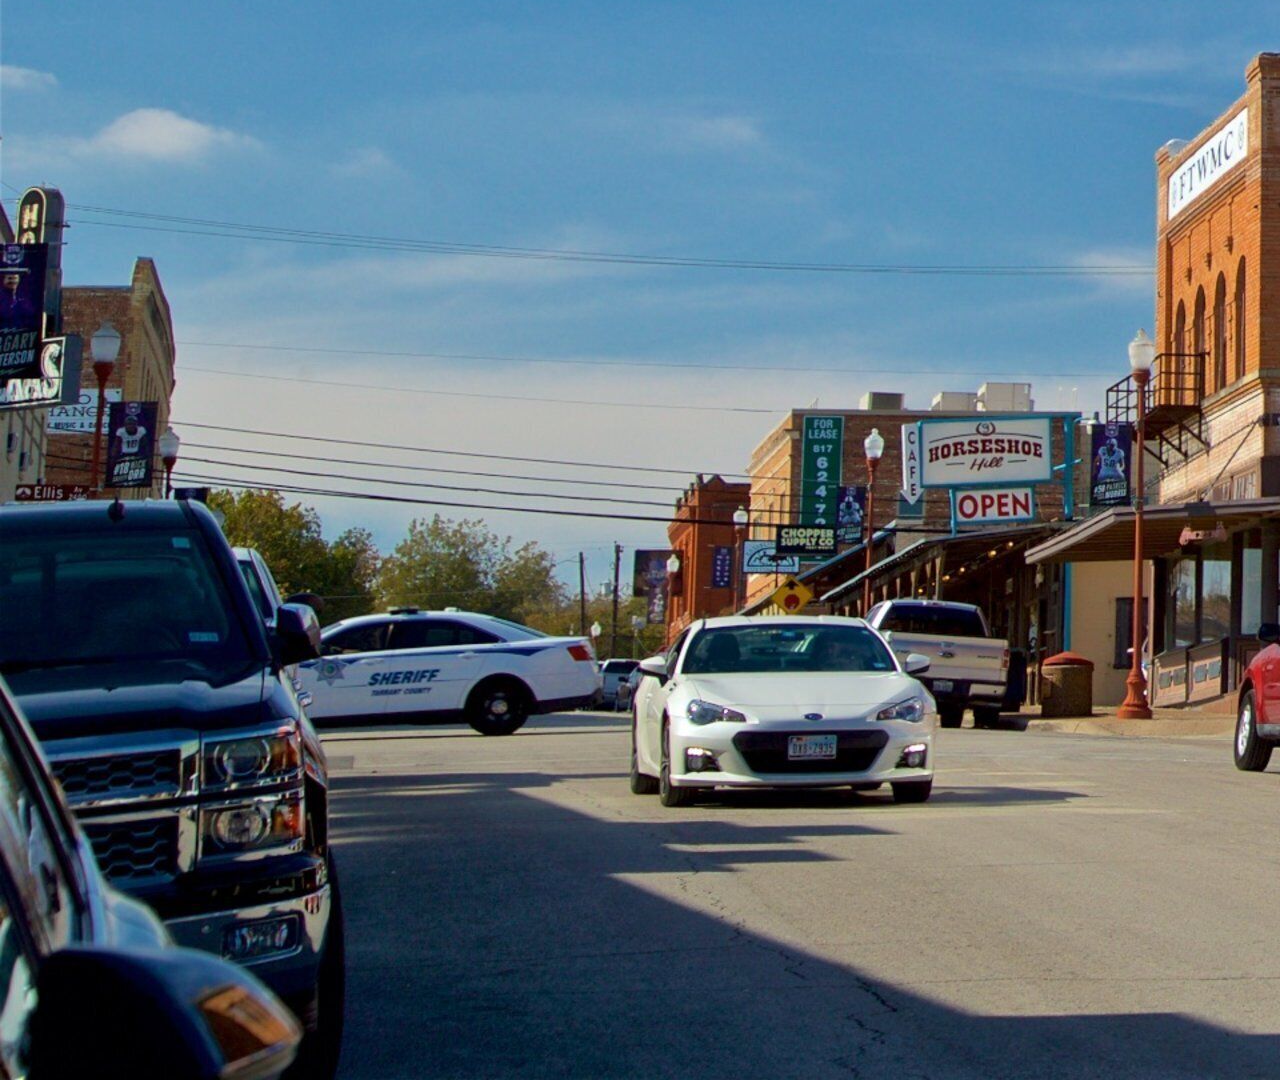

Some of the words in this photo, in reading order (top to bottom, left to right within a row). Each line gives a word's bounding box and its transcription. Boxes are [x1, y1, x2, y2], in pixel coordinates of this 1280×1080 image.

[1180, 130, 1234, 201] FTWMC
[814, 419, 833, 429] FOR
[809, 429, 838, 439] LEASE
[813, 444, 833, 453] 817
[928, 438, 1043, 464] HORSESHOE
[907, 431, 918, 497] CAFE
[969, 456, 1005, 472] Hill
[34, 486, 64, 500] Ellis
[958, 492, 1031, 519] OPEN
[781, 527, 835, 538] CHOPPER
[781, 537, 819, 546] SUPPLY
[819, 537, 835, 546] CO
[368, 668, 441, 686] SHERIFF
[370, 688, 403, 697] TARRANT
[403, 686, 432, 696] COUNTY
